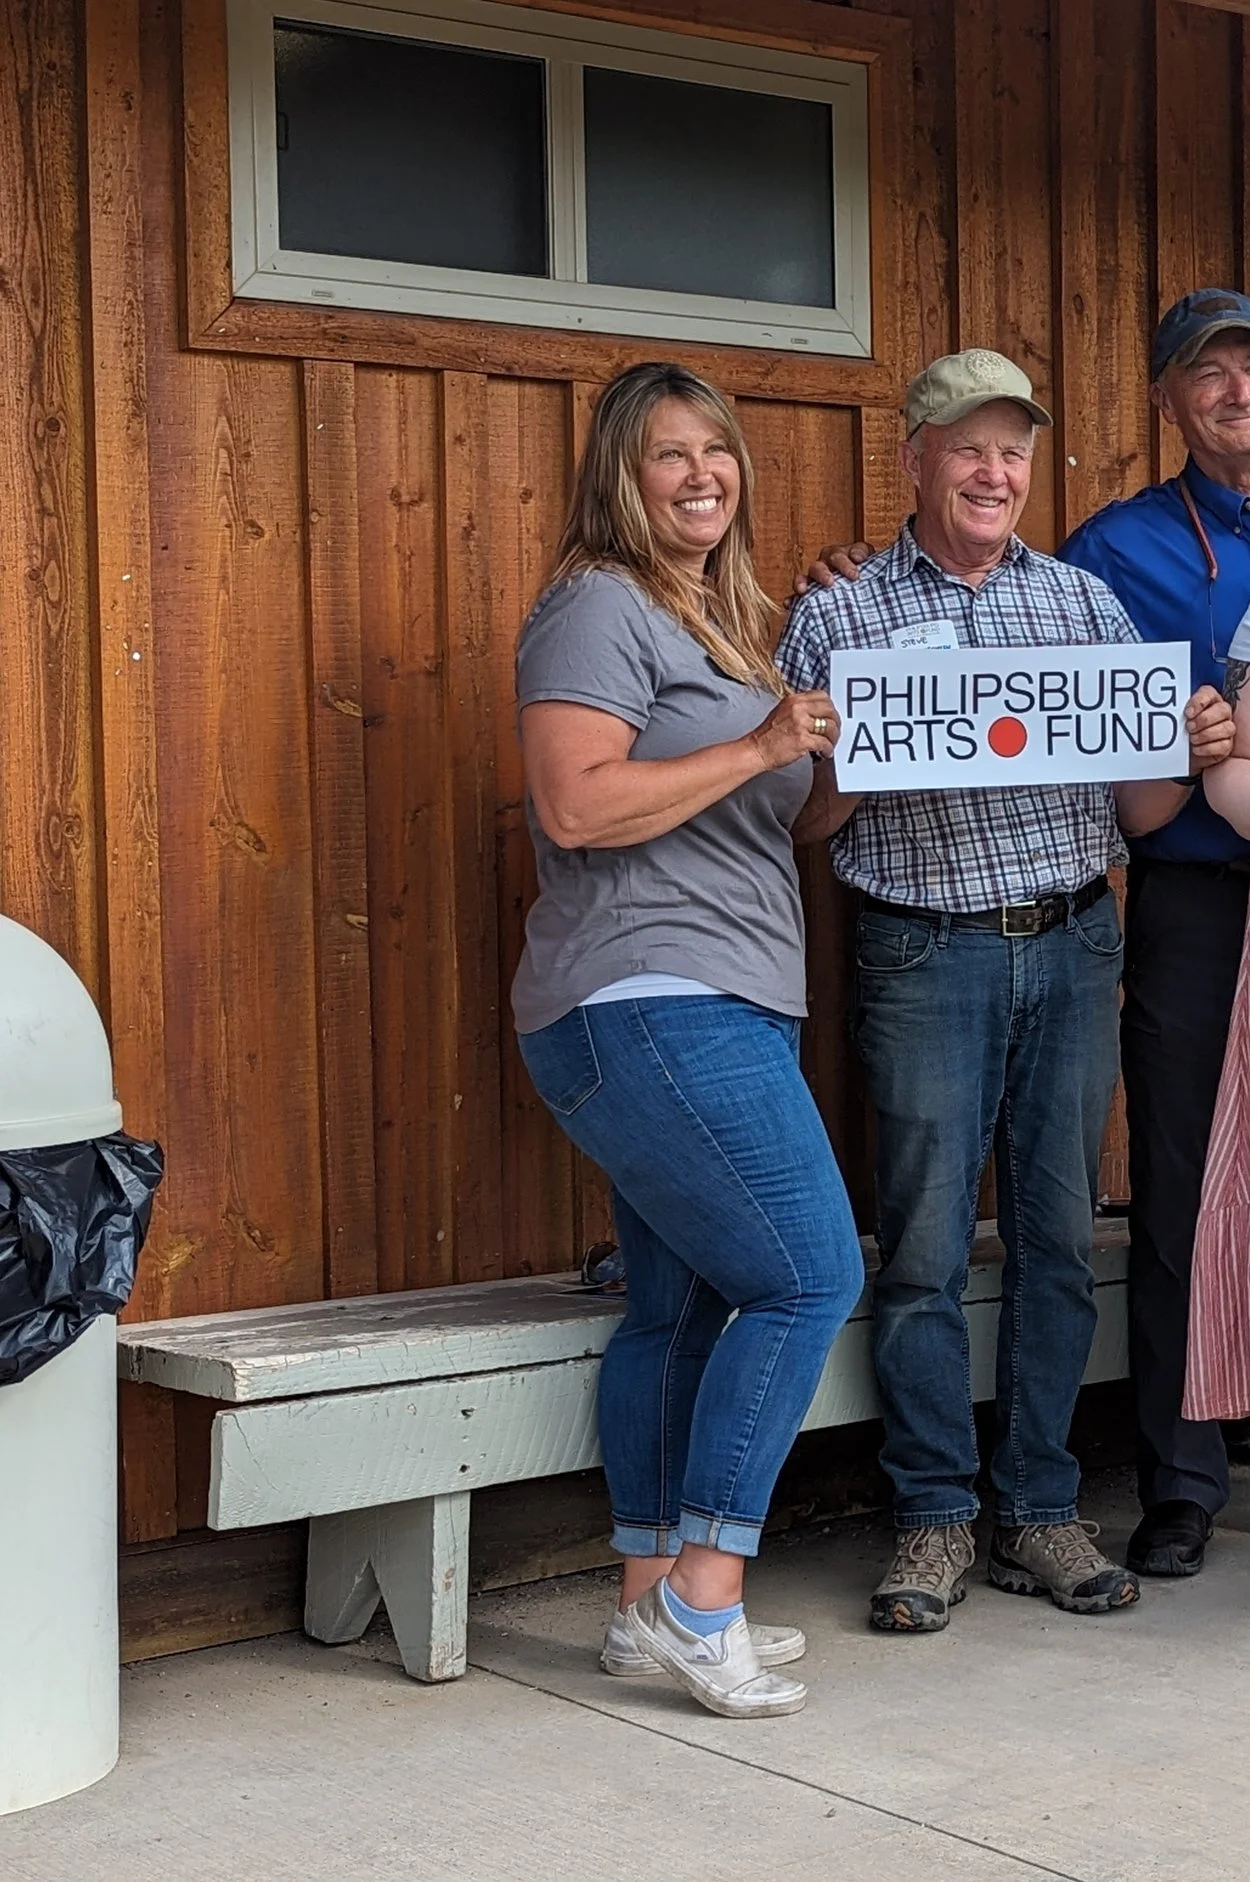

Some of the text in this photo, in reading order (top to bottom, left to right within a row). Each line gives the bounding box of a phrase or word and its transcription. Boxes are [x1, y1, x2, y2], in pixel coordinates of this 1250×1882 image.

[845, 666, 1177, 719] PHILIPSBURG
[847, 711, 1179, 764] ARTS FUND
